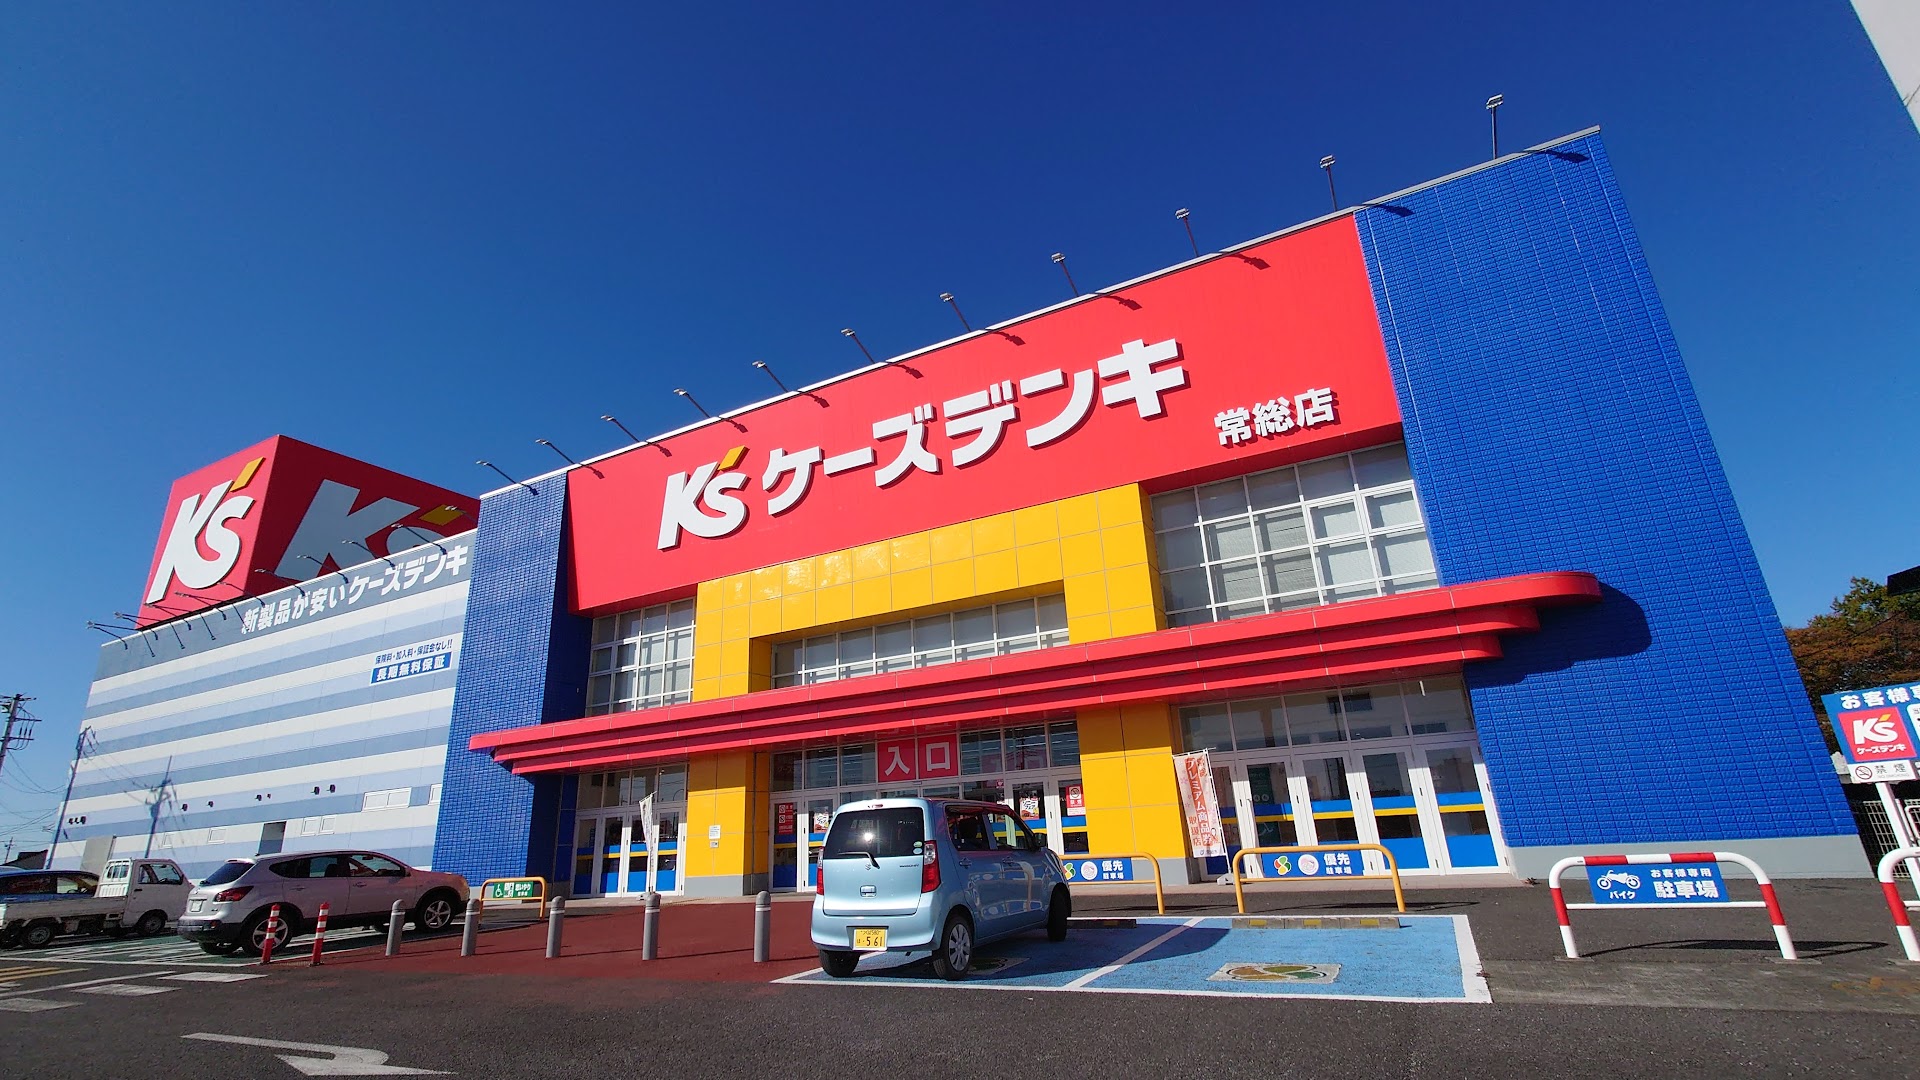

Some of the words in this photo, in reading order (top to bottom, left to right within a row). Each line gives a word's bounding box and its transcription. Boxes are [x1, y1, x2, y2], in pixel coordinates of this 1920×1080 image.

[1213, 387, 1337, 446] 常総店
[657, 445, 749, 552] K's
[762, 338, 1187, 517] ケーズデンキ
[145, 456, 266, 605] K's
[376, 654, 446, 682] 長期無料保証
[1852, 714, 1899, 745] K's
[1856, 743, 1907, 755] ケーズデンキ
[884, 741, 951, 777] 入口
[1185, 758, 1213, 846] プレミアム商品券
[1102, 860, 1124, 872] 優先
[1323, 852, 1350, 866] 優先
[1102, 872, 1124, 880] 駐車場
[1325, 866, 1352, 875] 駐車場
[1650, 867, 1713, 878] お客様専用
[1609, 890, 1636, 900] バイク
[1653, 880, 1719, 899] 駐車場
